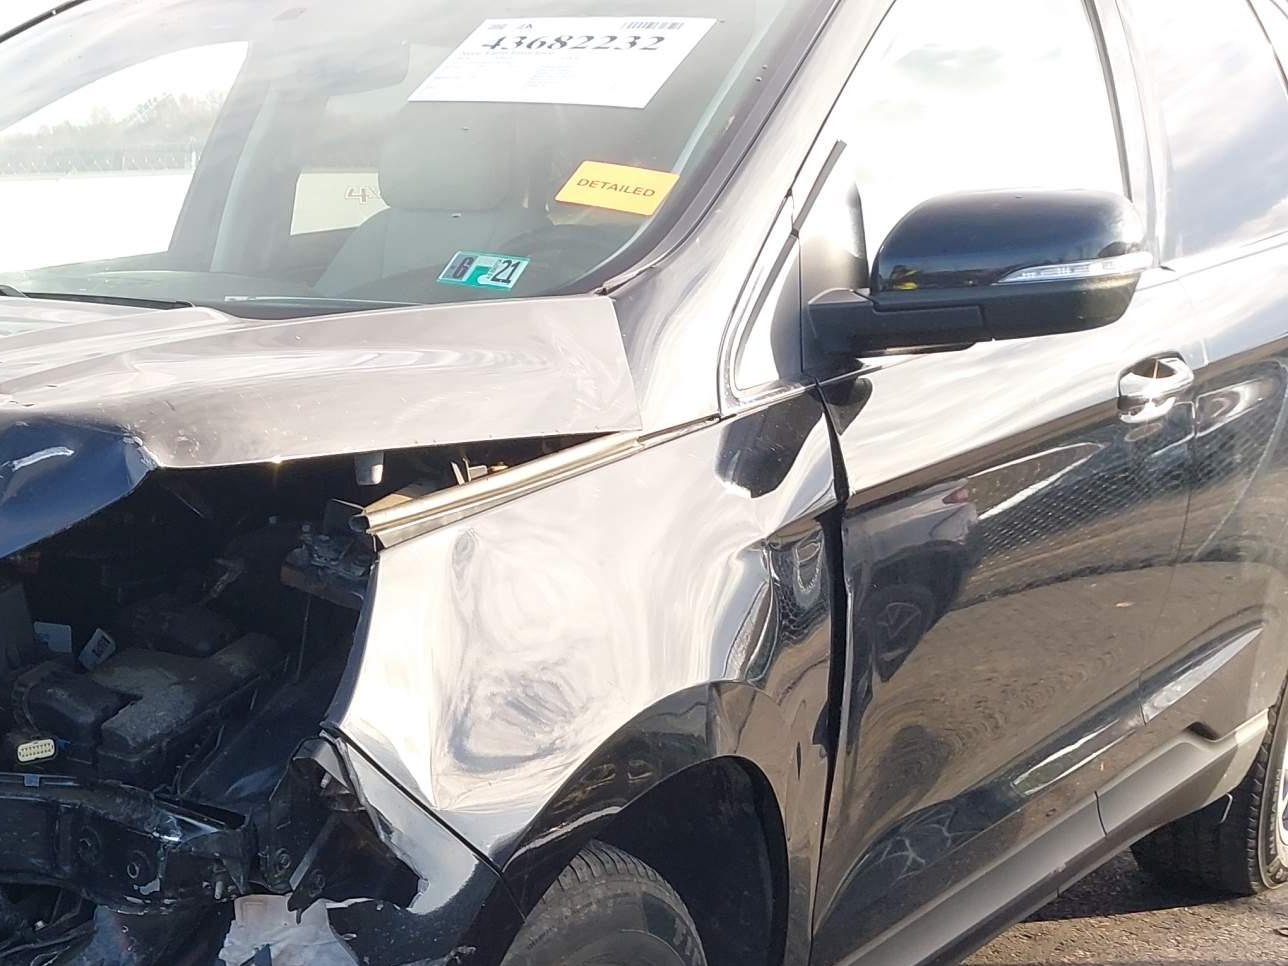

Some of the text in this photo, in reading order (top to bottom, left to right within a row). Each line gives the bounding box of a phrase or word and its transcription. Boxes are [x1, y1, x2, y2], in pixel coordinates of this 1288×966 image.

[481, 35, 665, 51] 43682232
[576, 178, 656, 197] DETAILED
[490, 259, 521, 284] 21
